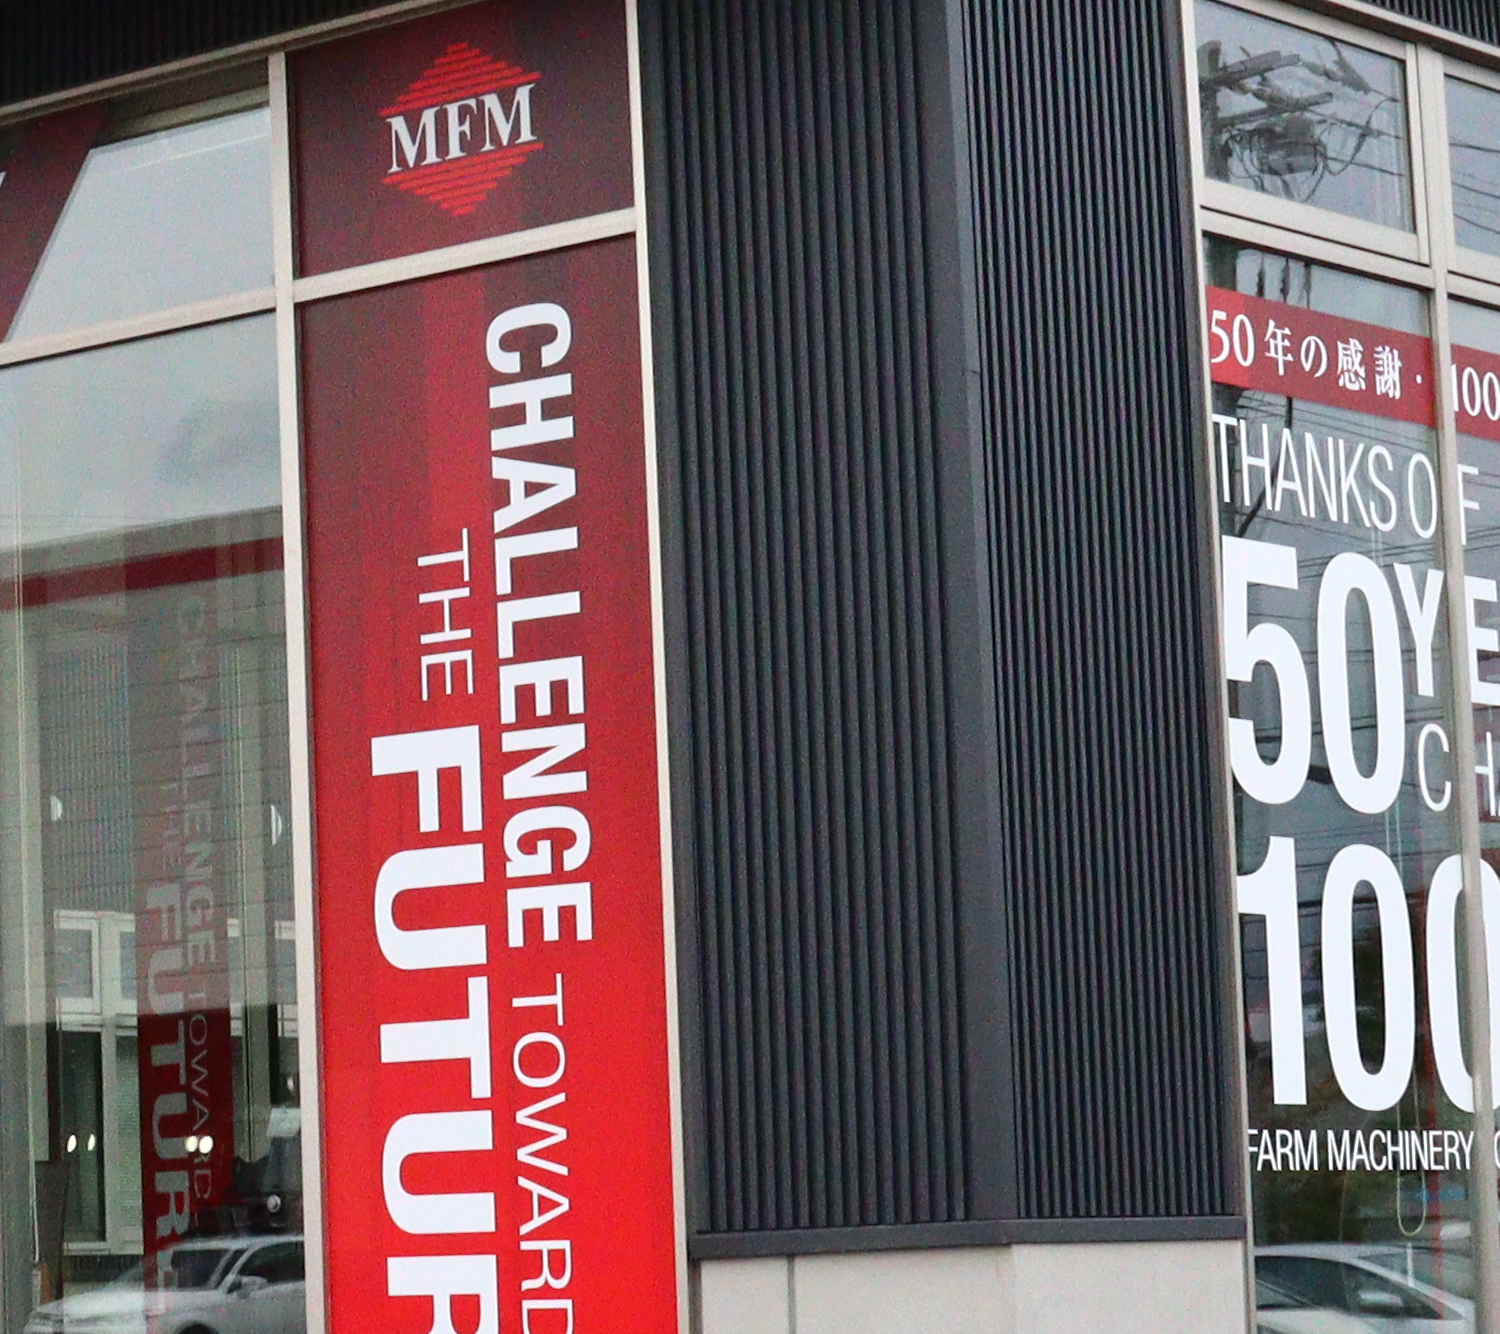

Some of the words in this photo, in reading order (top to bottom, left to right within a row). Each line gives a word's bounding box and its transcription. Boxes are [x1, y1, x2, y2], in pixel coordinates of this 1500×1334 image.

[386, 83, 537, 173] MFM
[1211, 413, 1398, 533] THANKS
[419, 528, 473, 702] THE
[485, 302, 594, 949] CHALLENGE
[1326, 1128, 1476, 1173] MACHINERY
